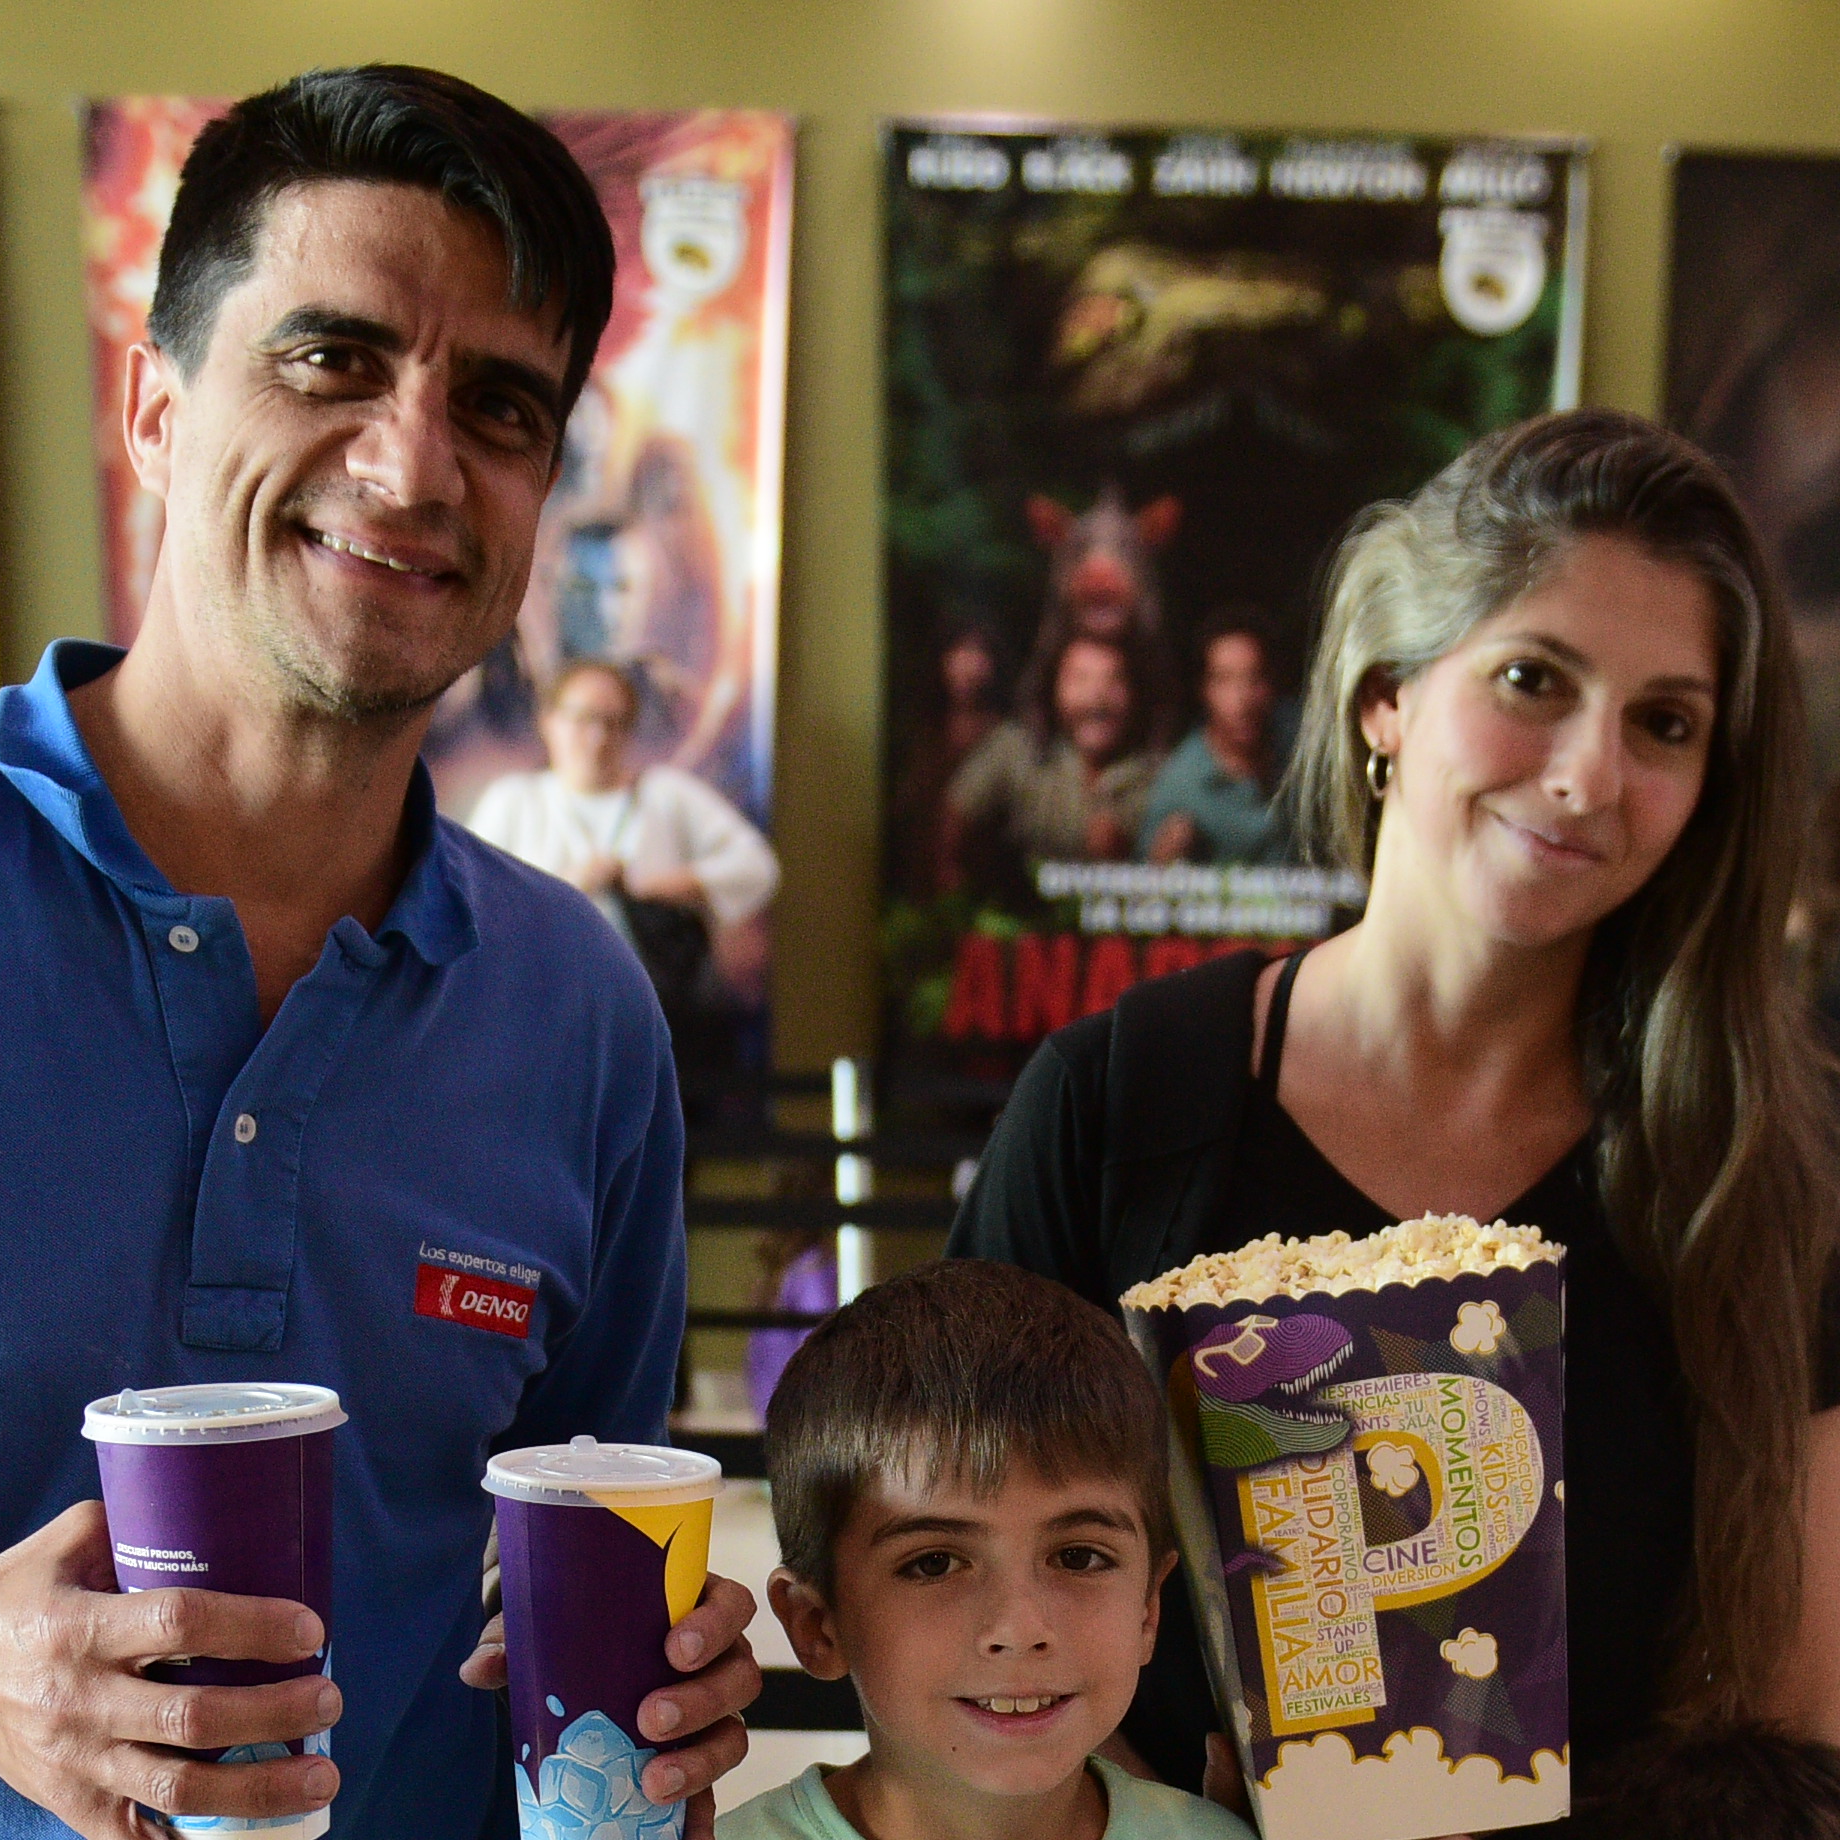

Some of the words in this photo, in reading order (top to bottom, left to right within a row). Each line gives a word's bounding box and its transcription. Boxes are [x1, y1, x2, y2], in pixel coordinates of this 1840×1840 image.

[419, 1240, 447, 1261] Los
[448, 1251, 507, 1275] expertos
[460, 1290, 529, 1323] DENSO
[1345, 1372, 1431, 1399] PREMIERES
[1405, 1401, 1424, 1415] TU
[1473, 1380, 1491, 1439] SHOWS
[1399, 1413, 1437, 1431] SALA
[1504, 1435, 1518, 1484] FAMILIA
[1511, 1407, 1535, 1505] EDUCACION
[1438, 1378, 1483, 1568] MOMENTOS
[1480, 1442, 1511, 1509] KIDS
[1332, 1466, 1358, 1581] CORPORATIVO
[1493, 1509, 1508, 1543] KIDS
[144, 1561, 179, 1572] MUCHO
[180, 1561, 209, 1572] MÁS!
[150, 1550, 196, 1561] PROMOS,
[1363, 1540, 1439, 1574] CINE
[1253, 1476, 1314, 1666] FAMILIA
[1372, 1562, 1455, 1588] DIVERSION
[1344, 1582, 1370, 1593] EXPOS
[1357, 1586, 1398, 1599] COMEDIA
[1317, 1621, 1368, 1641] STAND
[1318, 1613, 1369, 1627] EMOCIONES
[1317, 1648, 1372, 1664] EXPERIENCIAS
[1334, 1639, 1354, 1654] UP
[1281, 1656, 1382, 1695] AMOR
[1286, 1690, 1371, 1715] FESTIVALES
